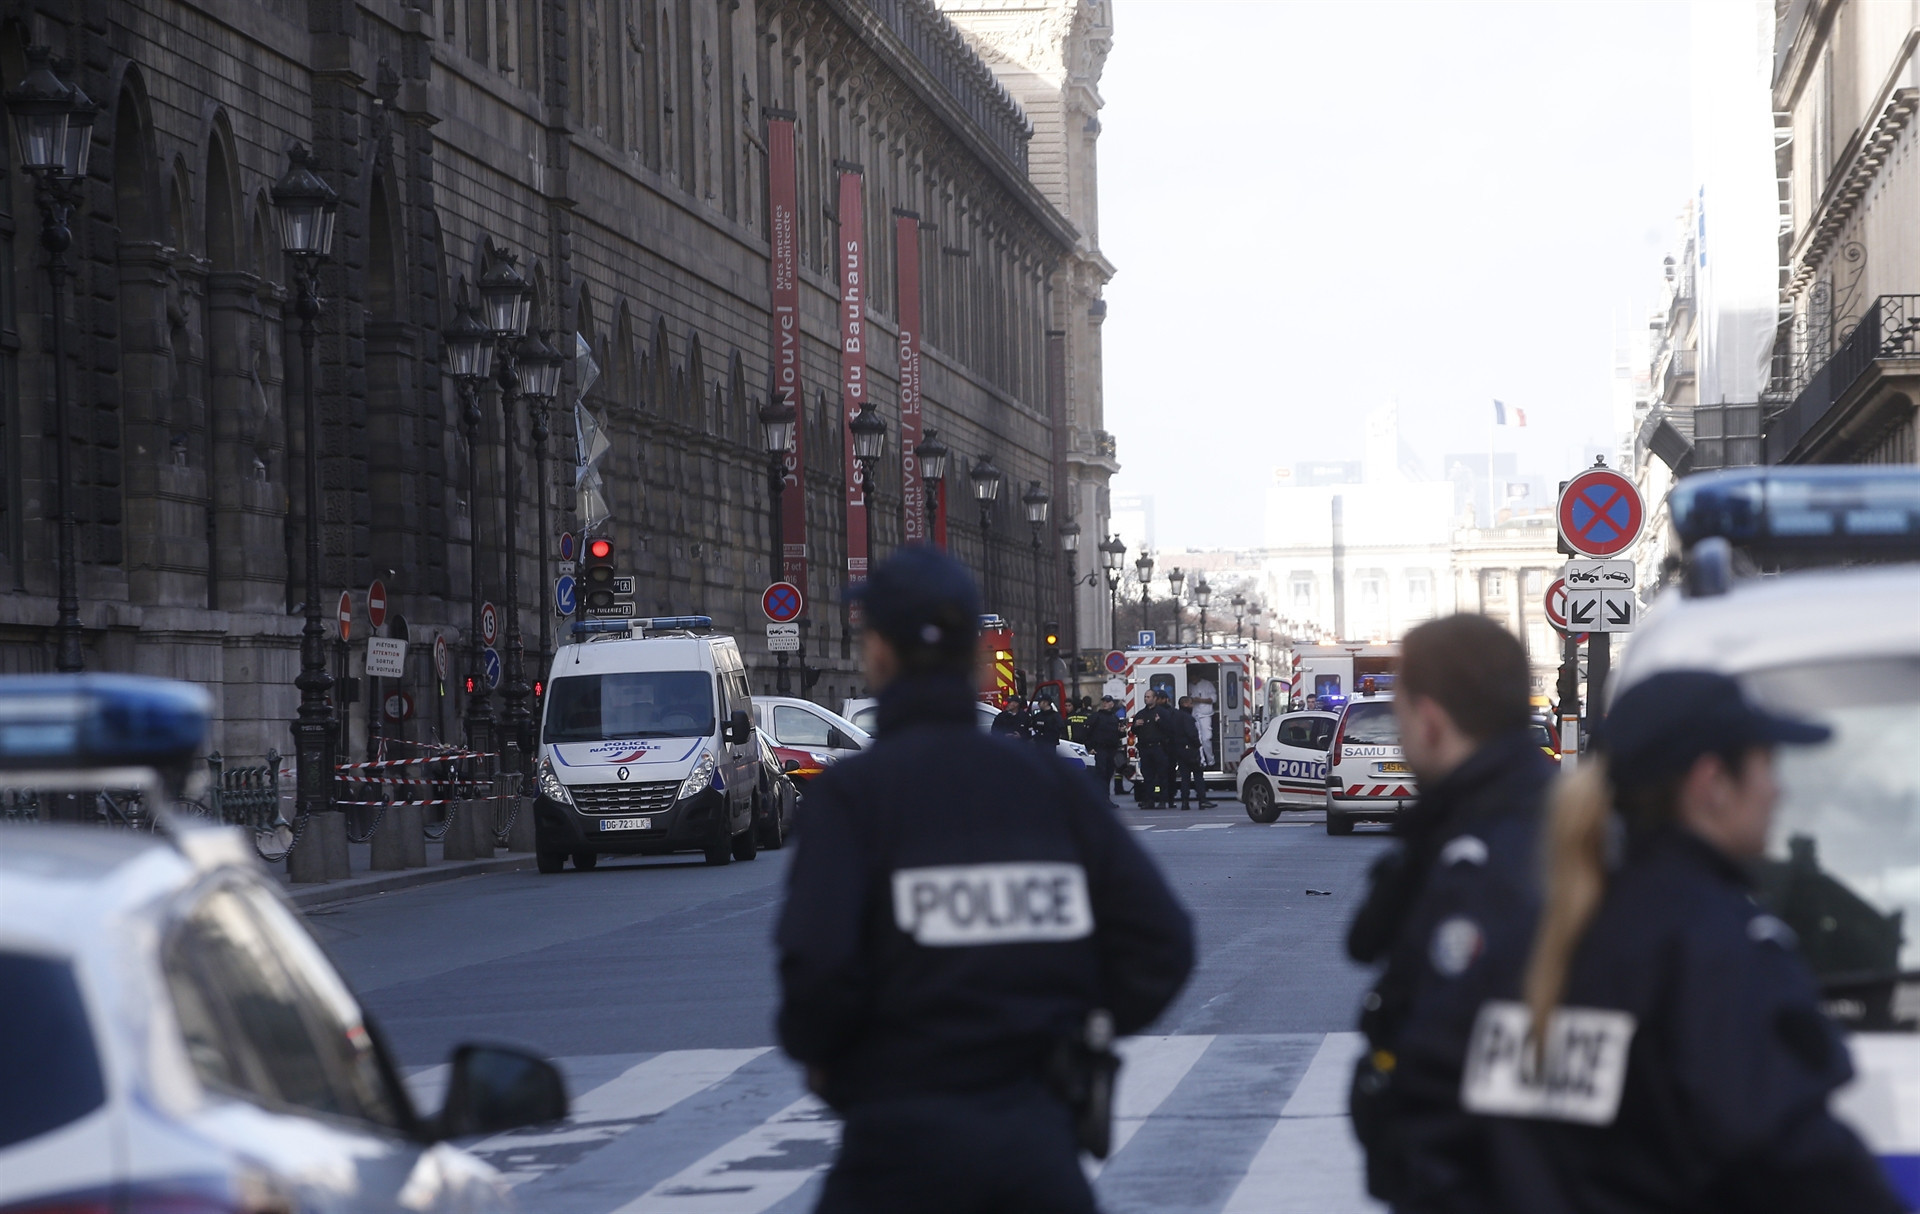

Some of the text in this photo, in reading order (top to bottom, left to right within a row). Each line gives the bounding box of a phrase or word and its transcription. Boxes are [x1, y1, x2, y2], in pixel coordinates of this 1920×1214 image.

[778, 306, 795, 406] Nouvel
[846, 241, 865, 506] L'est du Bauhaus
[901, 331, 913, 414] LOULOU
[791, 562, 802, 571] oct
[849, 574, 857, 582] 19
[485, 615, 494, 633] 15
[1142, 634, 1152, 645] P
[589, 745, 661, 753] NATIONALE
[1344, 747, 1387, 756] SAMU
[1277, 760, 1327, 779] POLIC
[913, 876, 1075, 928] POLICE
